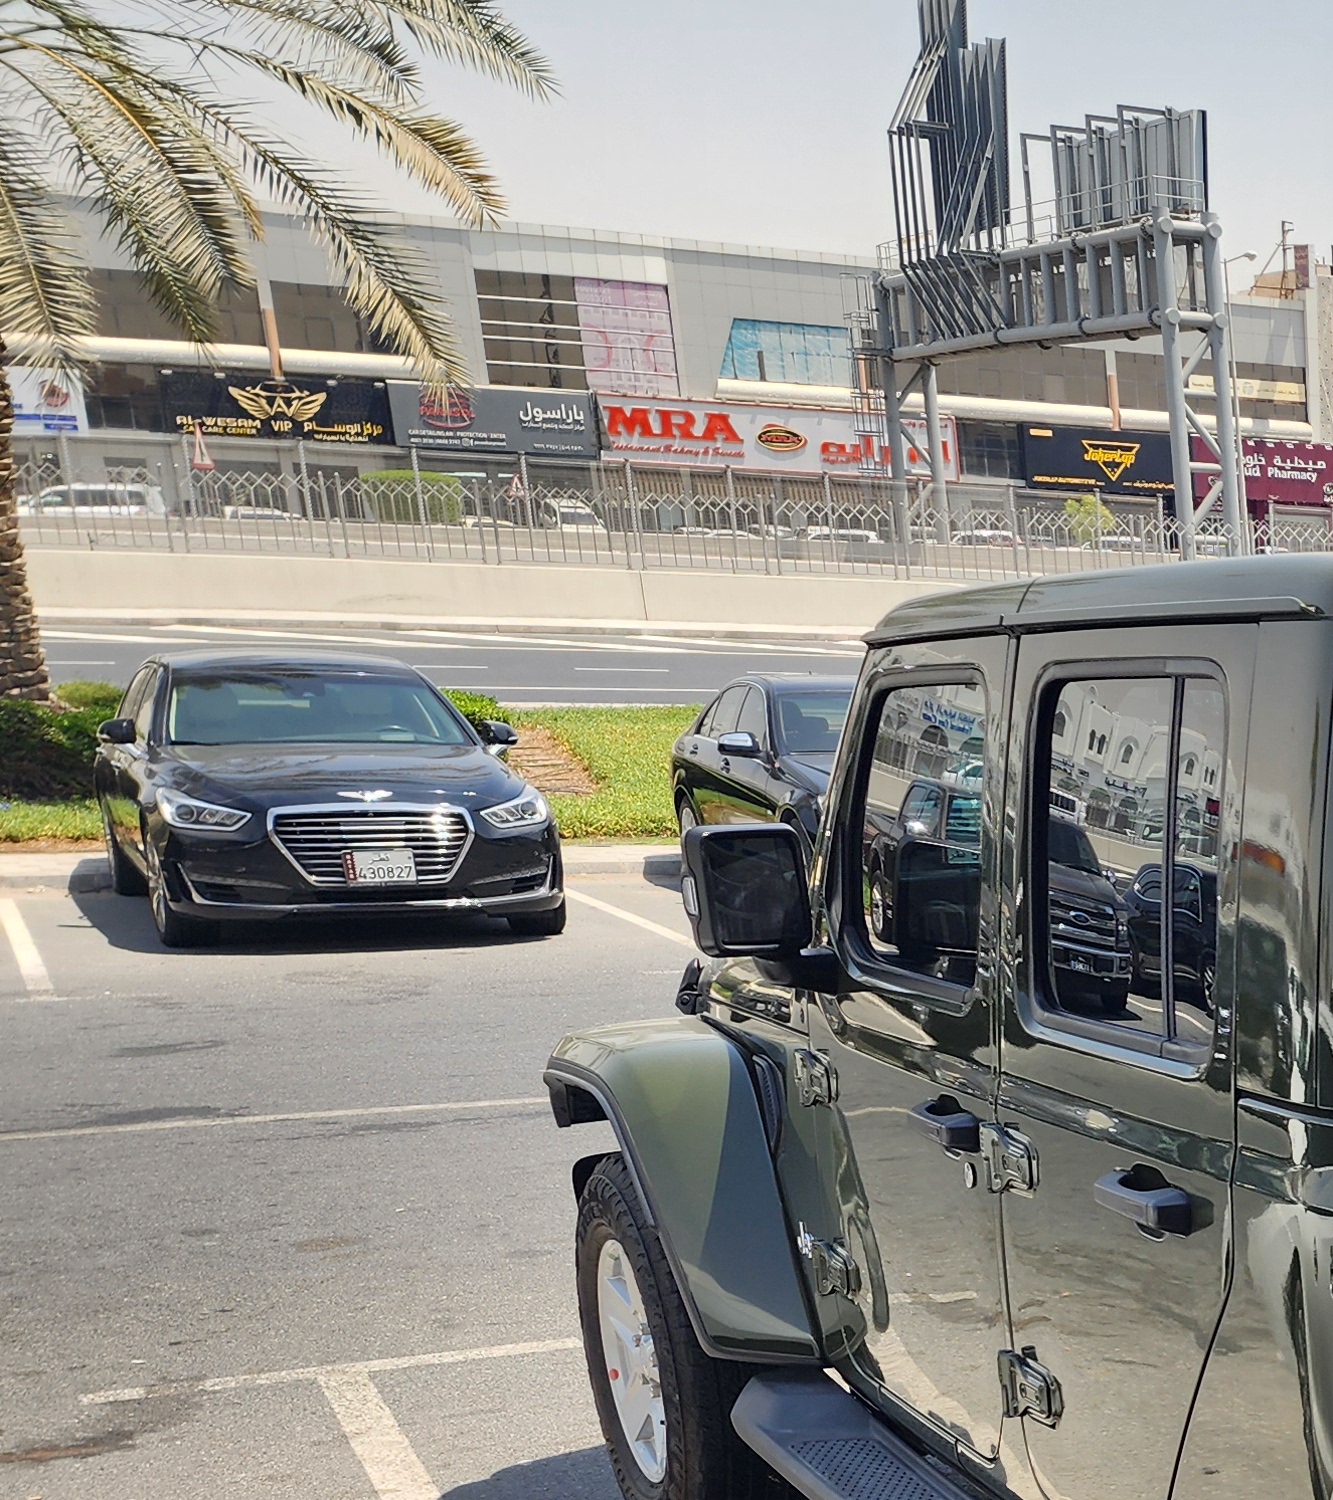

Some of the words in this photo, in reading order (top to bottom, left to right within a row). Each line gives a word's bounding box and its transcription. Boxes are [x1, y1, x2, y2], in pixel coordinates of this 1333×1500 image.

[519, 401, 584, 423] باراسول
[176, 415, 261, 428] AL-WESAM
[271, 419, 293, 432] VIP
[603, 405, 744, 444] MRA
[1273, 454, 1327, 471] صيدلية
[1267, 466, 1318, 483] Pharmacy
[358, 865, 413, 880] 430827
